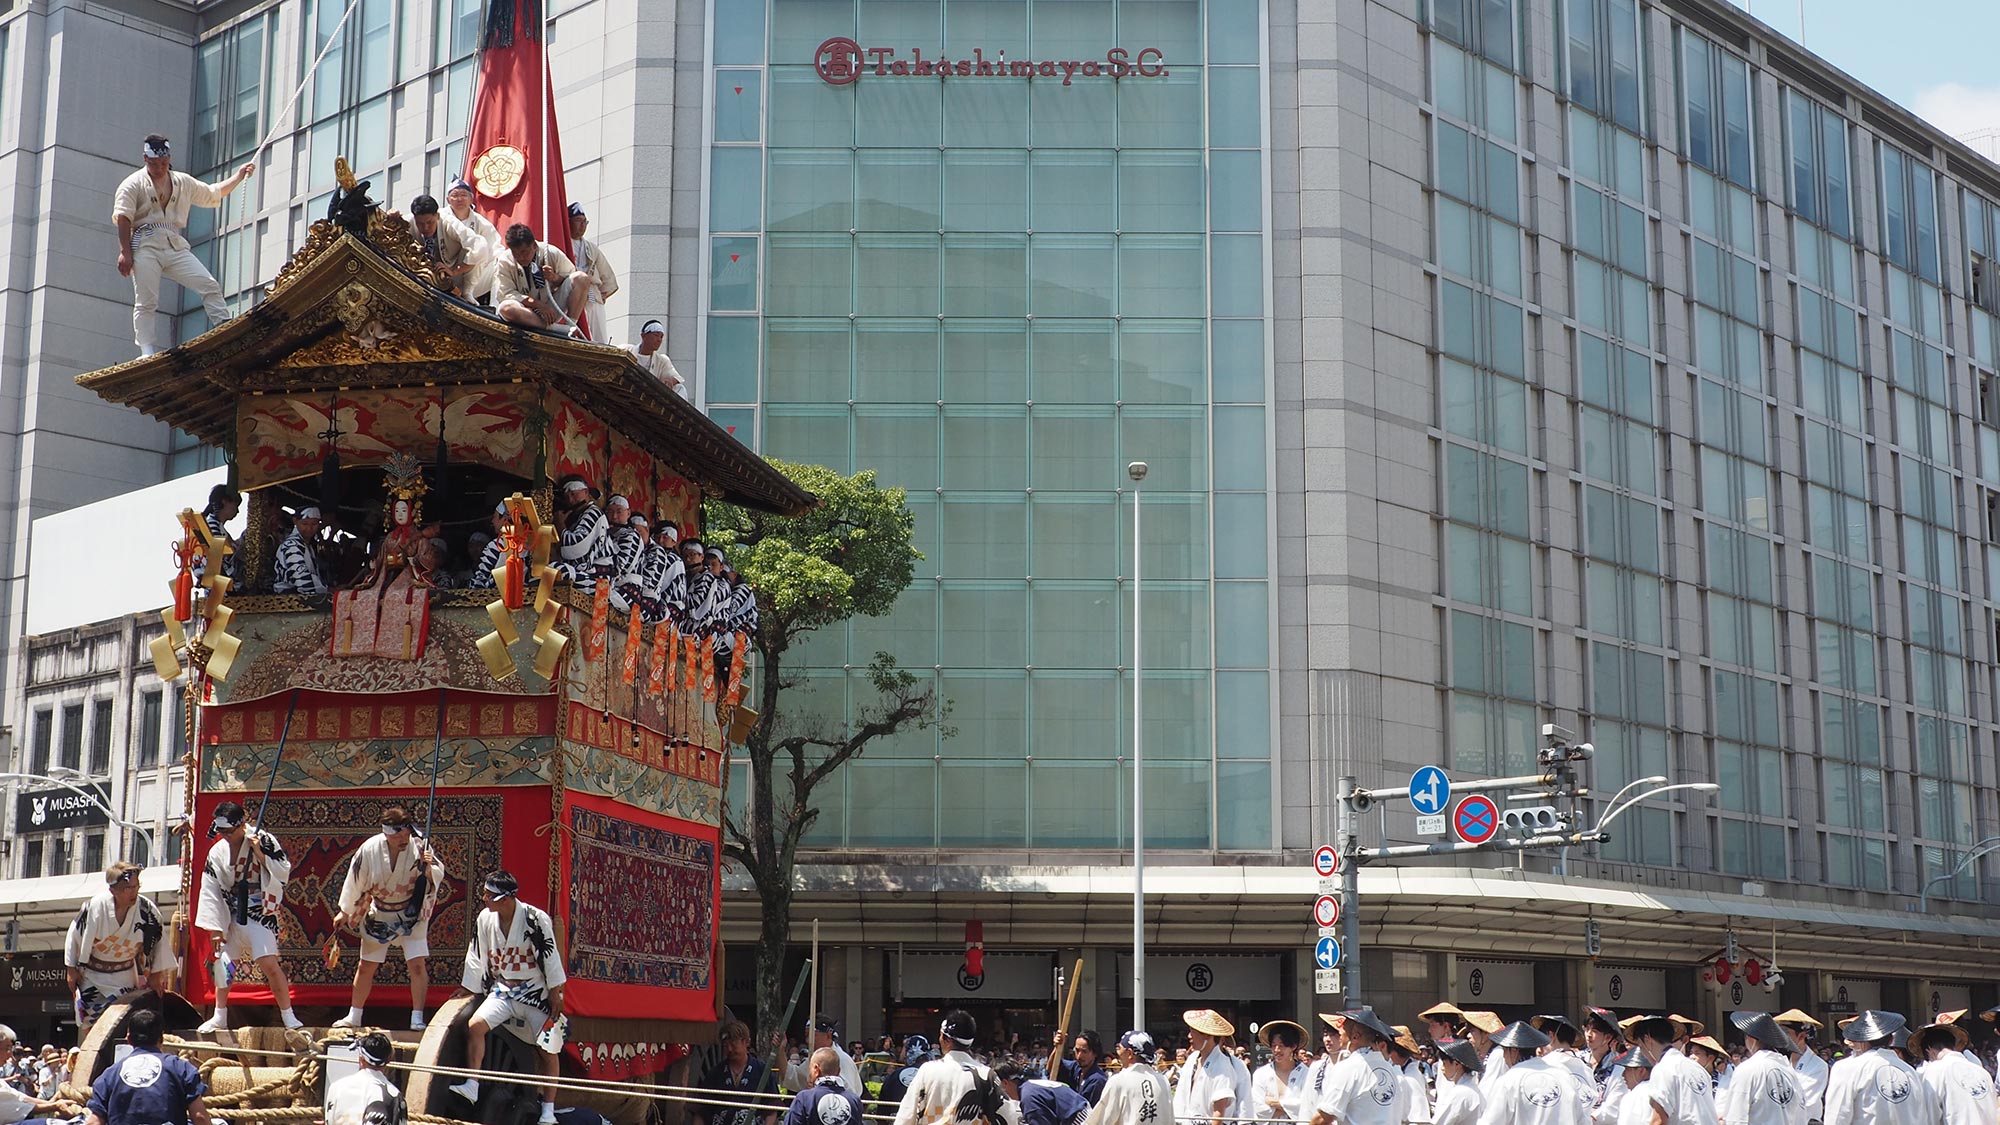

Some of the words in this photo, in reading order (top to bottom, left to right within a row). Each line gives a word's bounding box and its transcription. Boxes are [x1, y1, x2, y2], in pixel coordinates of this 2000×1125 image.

[49, 793, 98, 811] MUSASHI
[58, 810, 88, 819] JAPAN
[26, 969, 67, 981] MUSASHI
[1138, 1079, 1158, 1124] 月鉾
